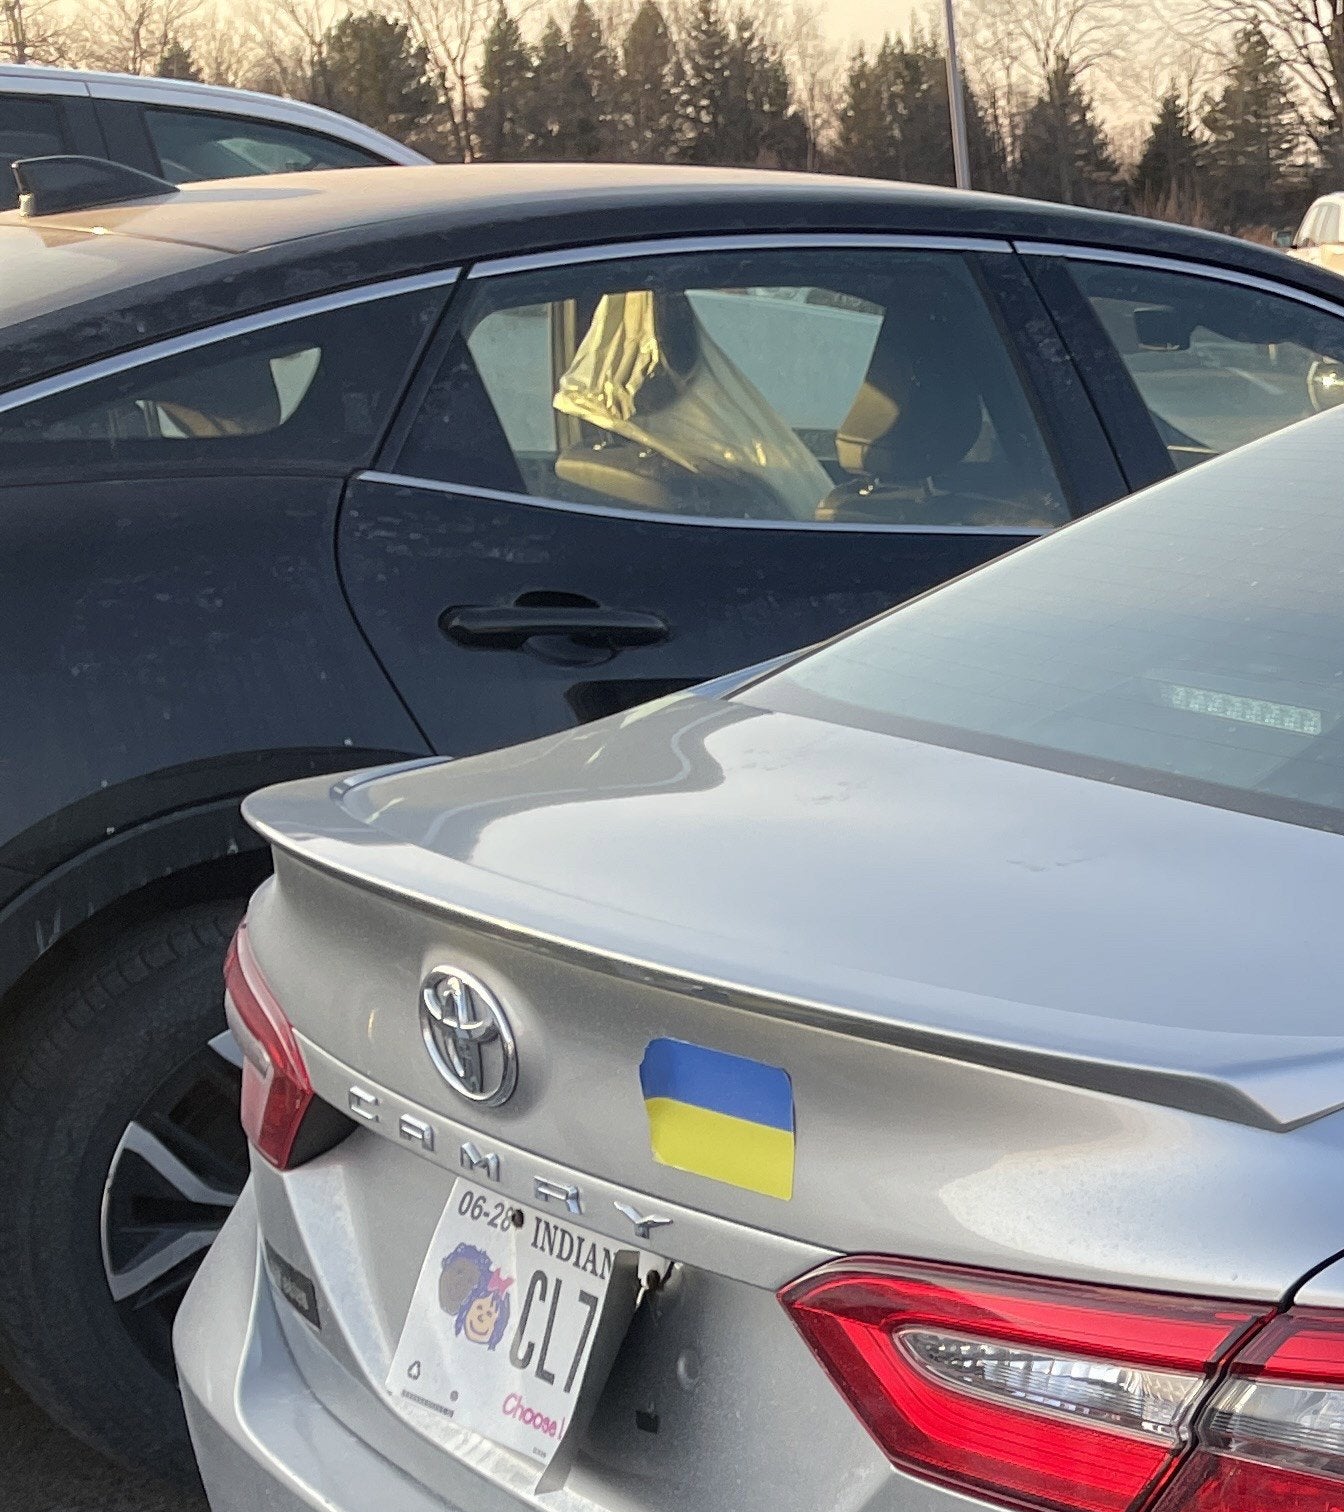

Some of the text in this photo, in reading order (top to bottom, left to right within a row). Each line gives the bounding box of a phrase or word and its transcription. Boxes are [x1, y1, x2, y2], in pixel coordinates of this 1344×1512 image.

[348, 1084, 674, 1240] CAMRY
[457, 1189, 515, 1233] 06-28
[508, 1269, 599, 1394] CL7
[502, 1392, 557, 1438] Choose
